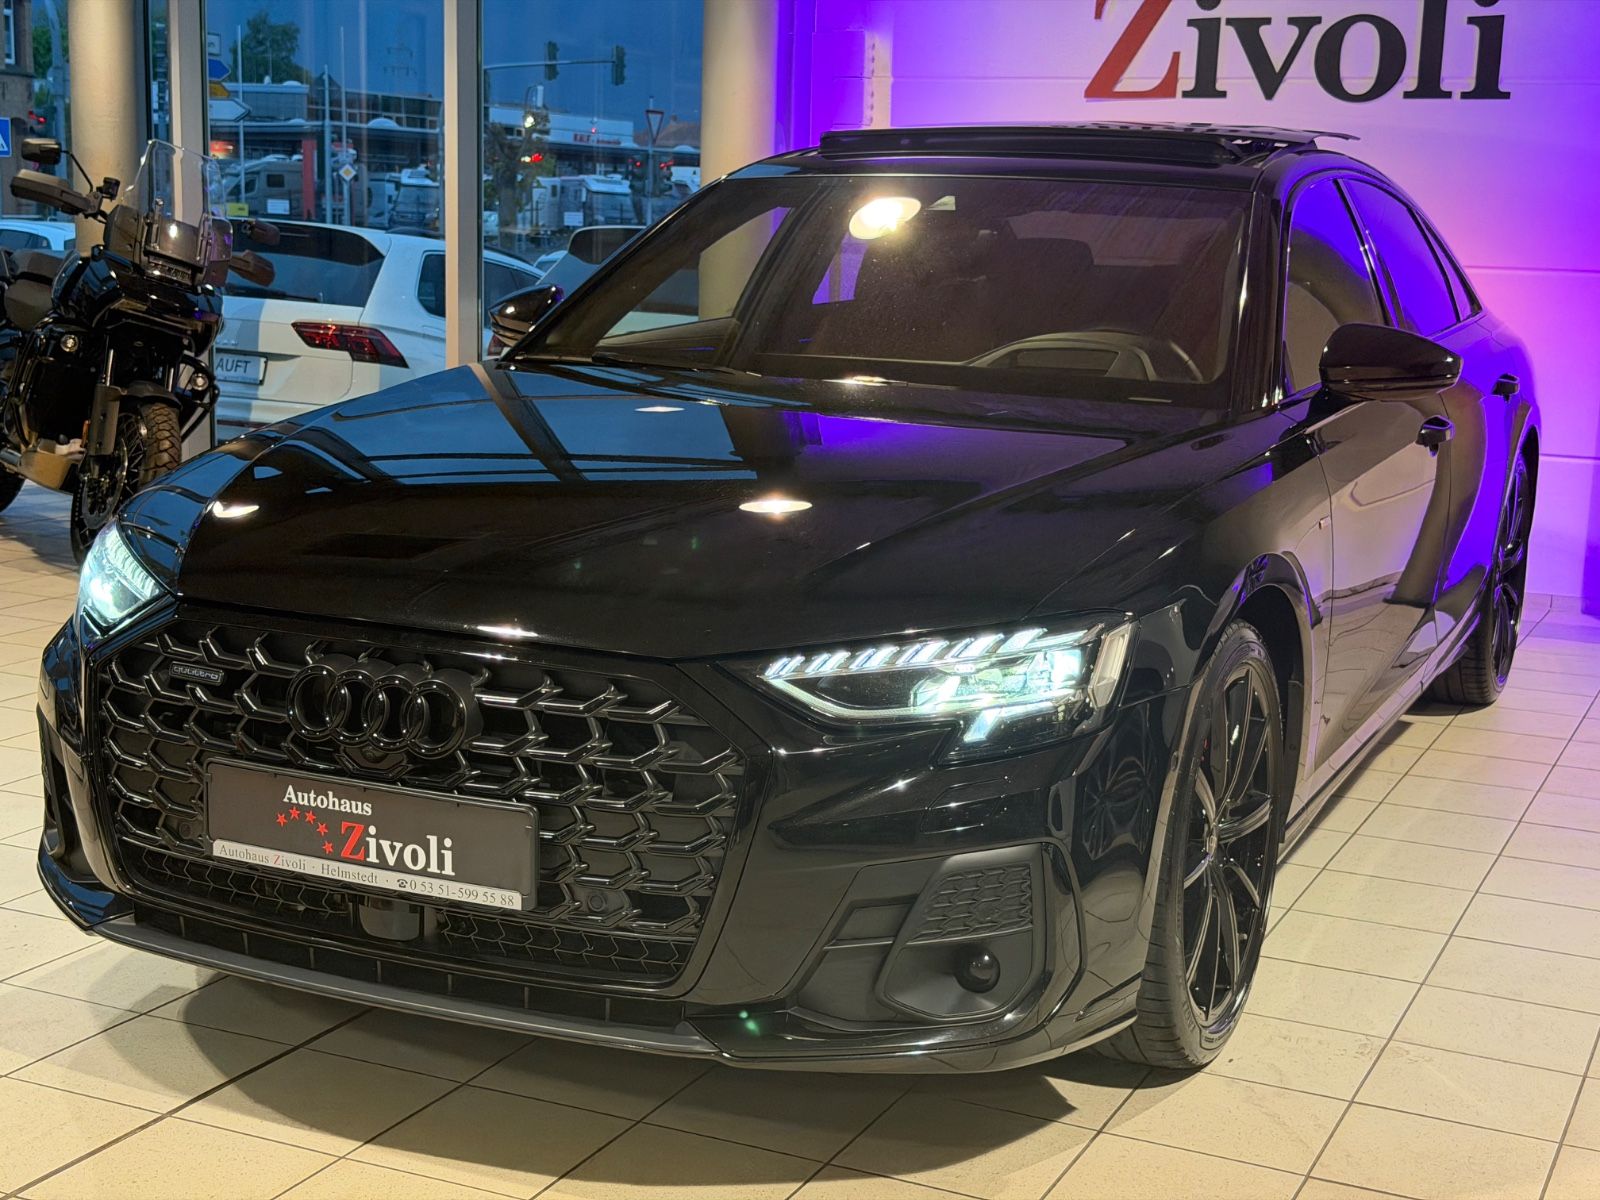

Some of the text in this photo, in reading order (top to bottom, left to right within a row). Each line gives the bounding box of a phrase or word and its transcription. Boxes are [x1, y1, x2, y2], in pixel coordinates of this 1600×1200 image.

[1084, 0, 1511, 102] Zivoli
[215, 358, 251, 373] AUFT
[173, 665, 219, 681] quattro
[283, 785, 372, 816] Autohaus
[340, 821, 455, 876] Zivoli
[219, 844, 269, 864] Autohaus
[273, 854, 306, 871] Zivoli
[321, 863, 378, 885] Helmstedt
[422, 881, 434, 894] 53
[483, 891, 496, 904] 55
[500, 894, 515, 907] 88
